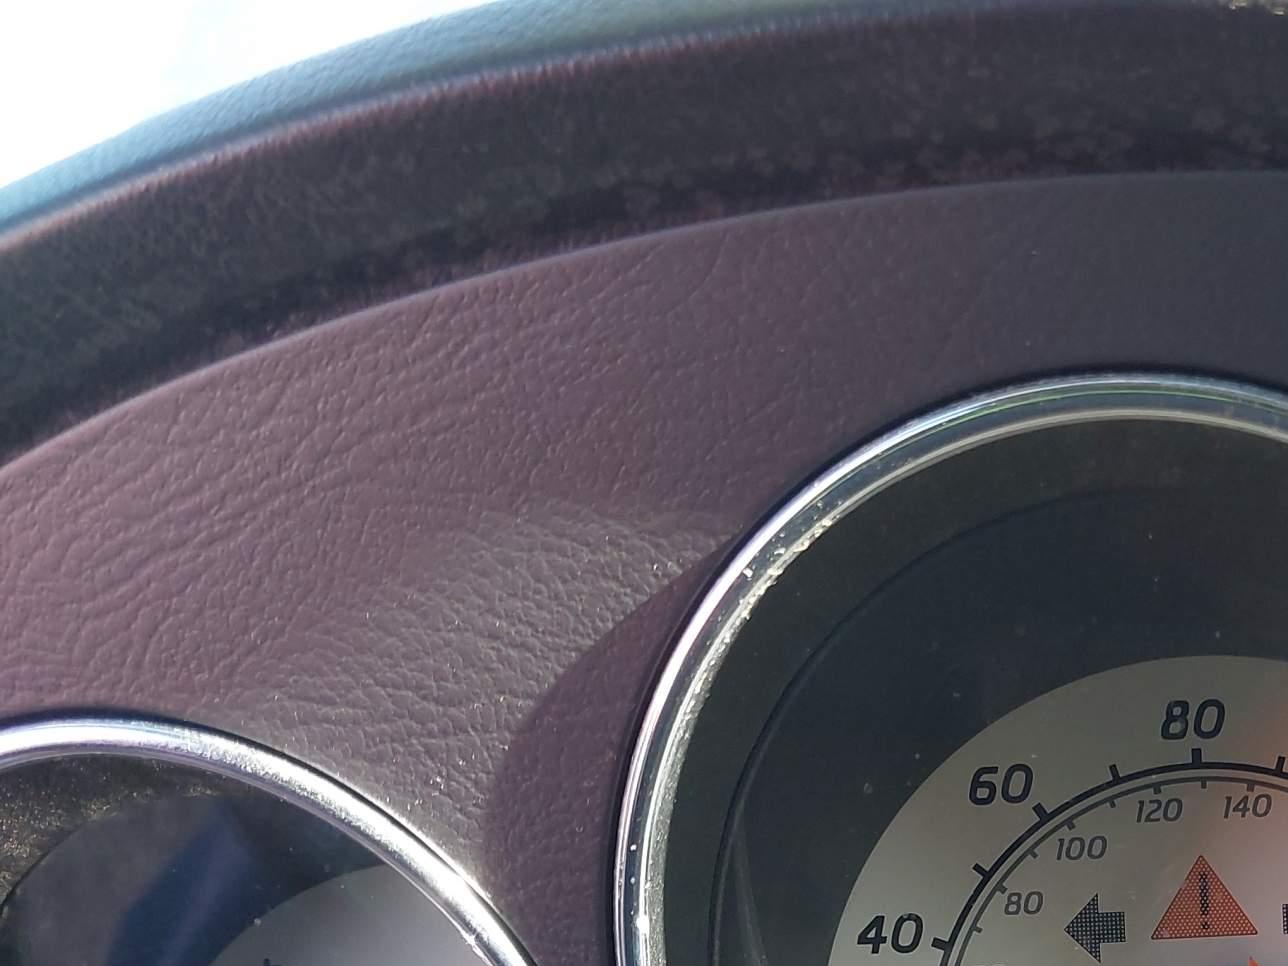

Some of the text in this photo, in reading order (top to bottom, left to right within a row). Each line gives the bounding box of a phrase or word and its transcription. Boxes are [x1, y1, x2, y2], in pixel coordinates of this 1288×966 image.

[1160, 698, 1226, 740] 80
[968, 764, 1034, 806] 60
[1135, 798, 1183, 824] 120
[1222, 793, 1274, 819] 140
[1056, 834, 1108, 862] 100
[1003, 890, 1044, 917] 80
[857, 913, 924, 954] 40
